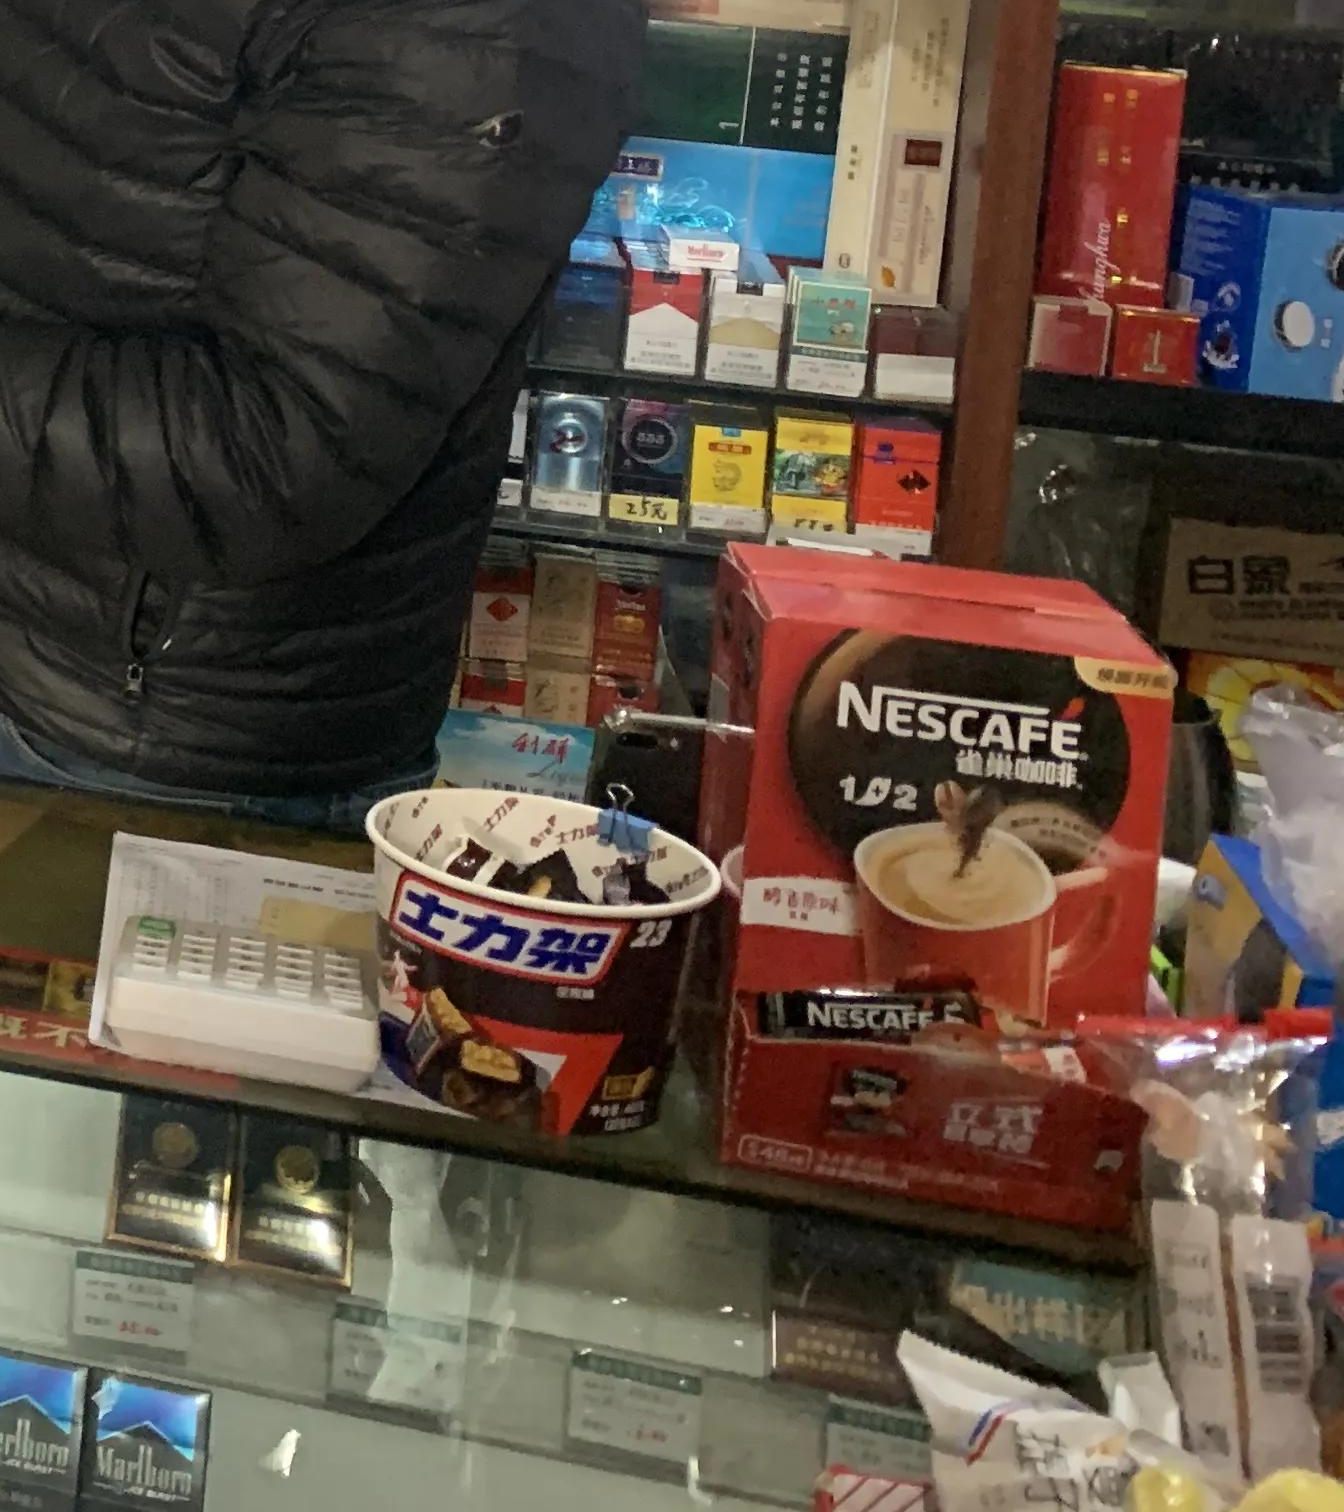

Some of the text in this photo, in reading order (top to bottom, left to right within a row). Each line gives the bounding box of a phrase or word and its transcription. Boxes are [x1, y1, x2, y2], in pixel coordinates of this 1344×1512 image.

[955, 749, 1078, 788] 雀巢咖啡
[397, 888, 612, 976] 士力架
[96, 1444, 193, 1494] Marlboro
